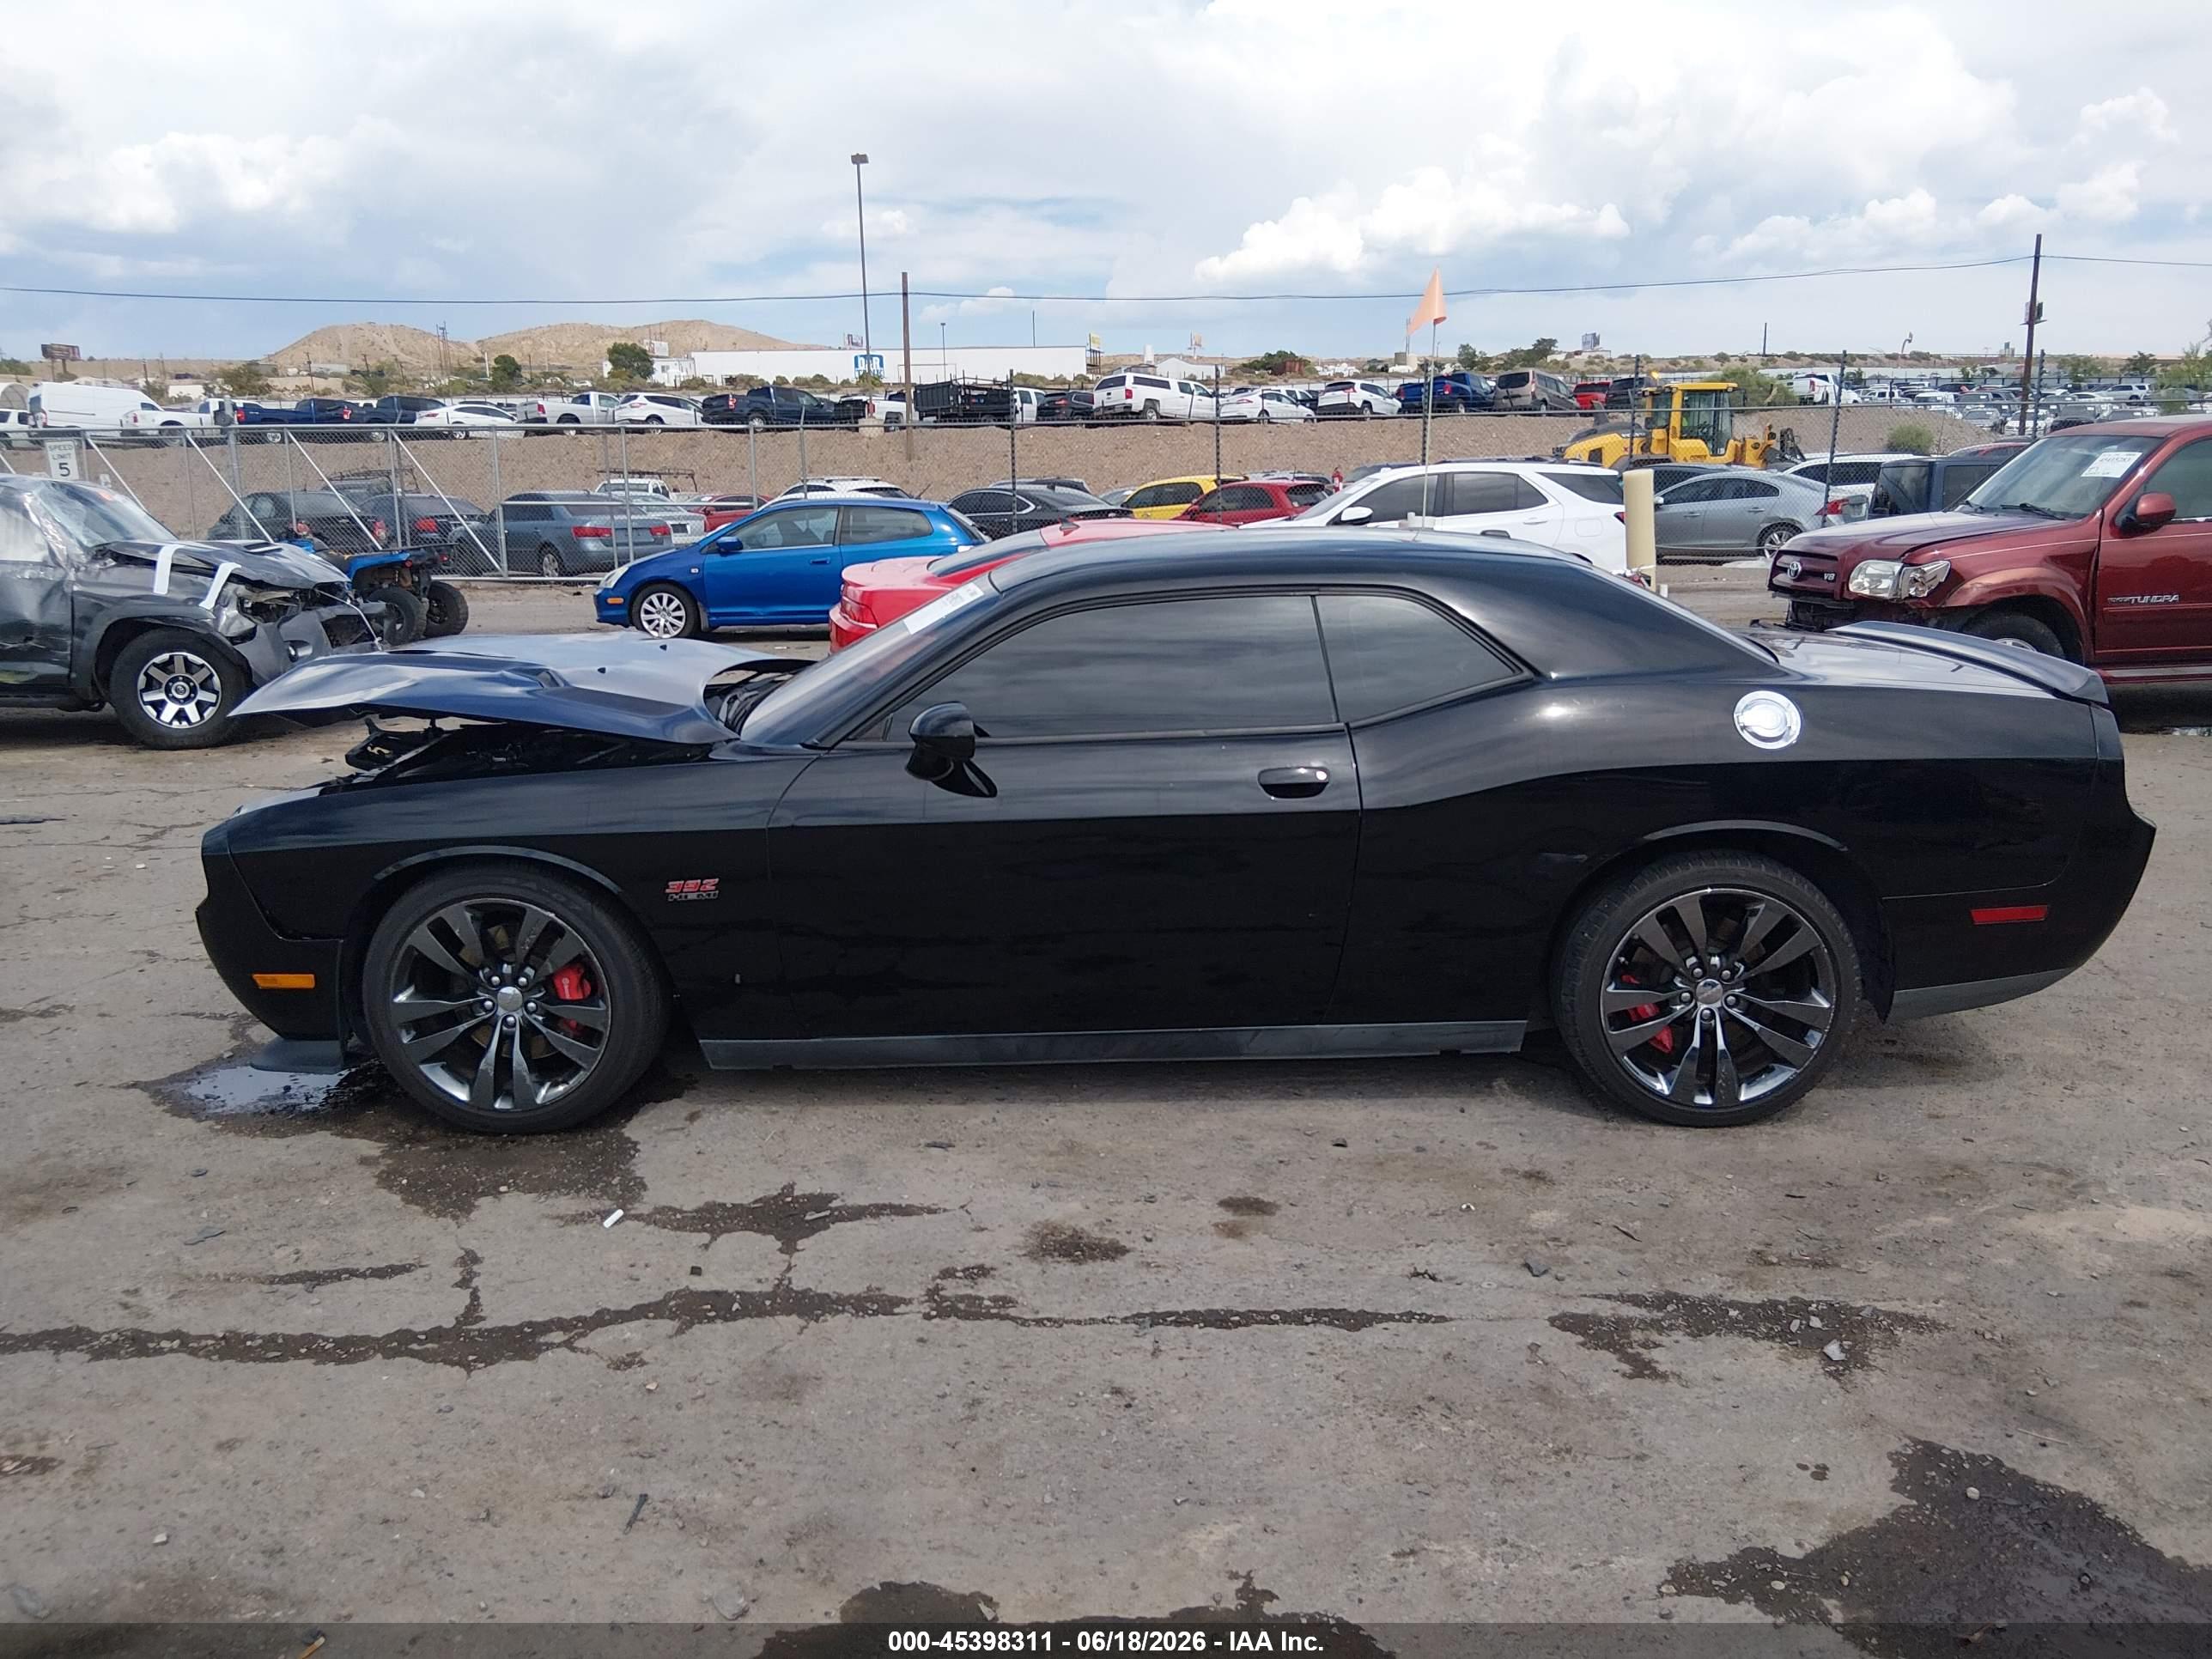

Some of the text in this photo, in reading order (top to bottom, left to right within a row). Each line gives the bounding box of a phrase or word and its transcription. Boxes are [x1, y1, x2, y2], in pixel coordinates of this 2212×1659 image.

[58, 462, 70, 477] 5
[2130, 594, 2179, 605] TUNDRA
[665, 878, 719, 893] 392
